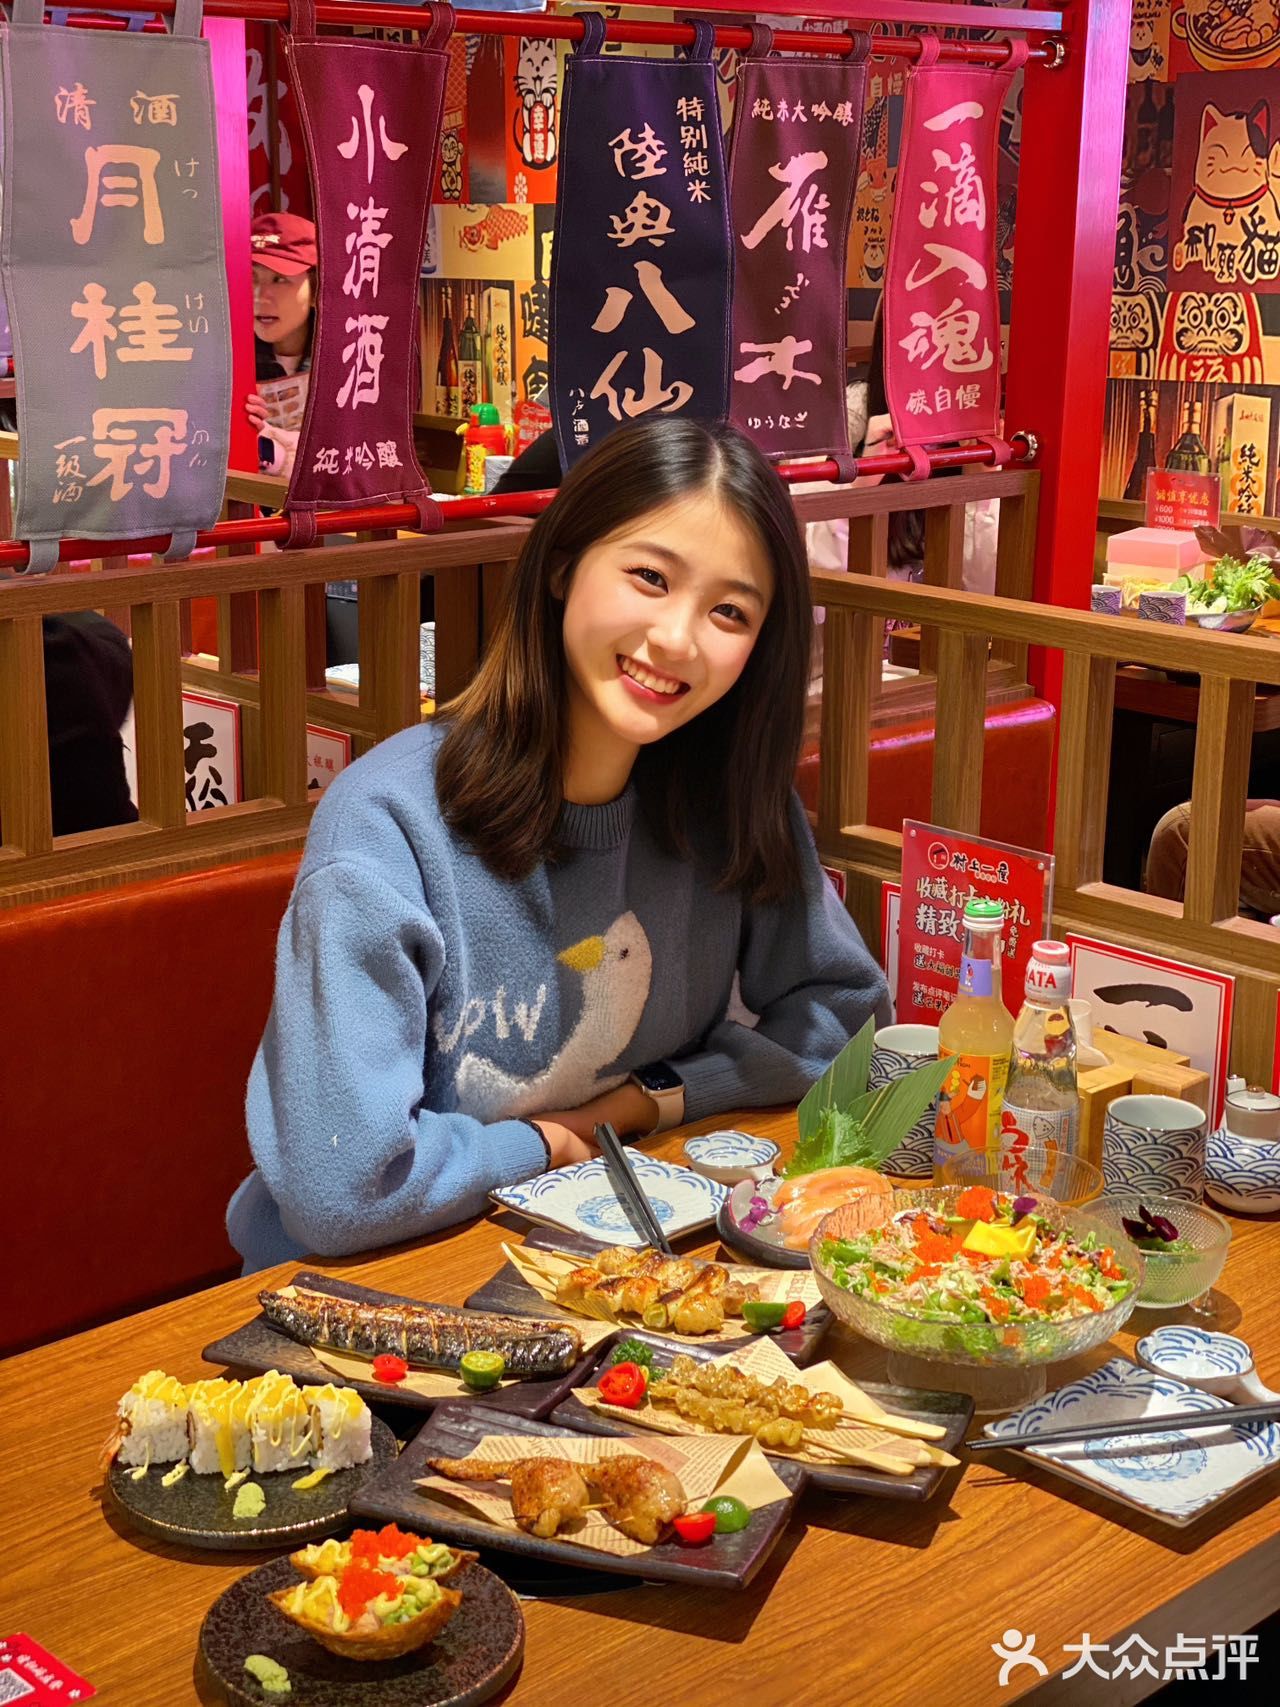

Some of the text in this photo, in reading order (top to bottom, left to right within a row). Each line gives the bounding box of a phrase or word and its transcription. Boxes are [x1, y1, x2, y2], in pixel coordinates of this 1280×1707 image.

[54, 82, 180, 130] 清酒
[899, 102, 993, 372] 一滴入魂
[69, 144, 193, 502] 月桂冠
[336, 84, 409, 410] 小清酒
[1025, 969, 1057, 989] ATA
